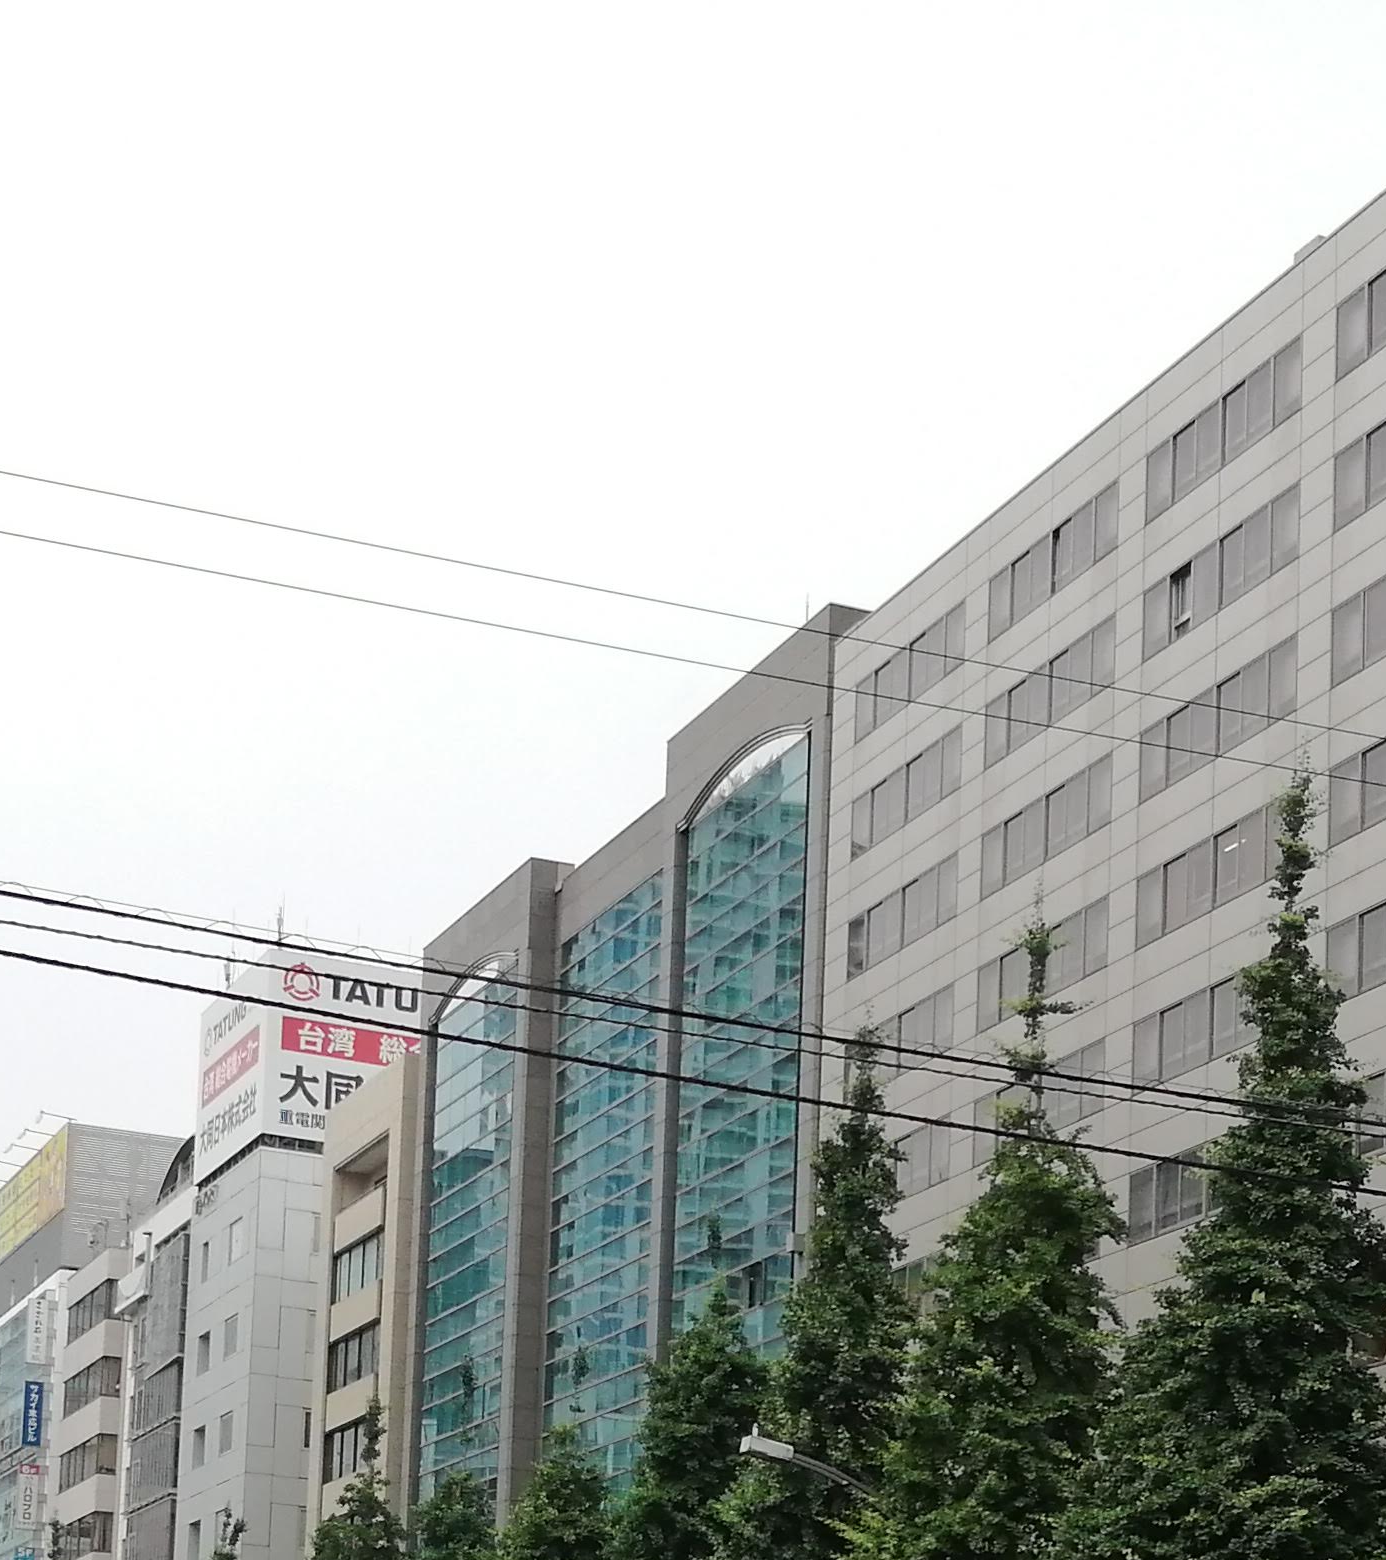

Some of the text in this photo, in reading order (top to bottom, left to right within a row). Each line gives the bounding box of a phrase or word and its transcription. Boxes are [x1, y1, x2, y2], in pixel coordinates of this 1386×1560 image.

[212, 1002, 247, 1045] TATUNG
[297, 1022, 356, 1058] 台湾
[279, 1065, 364, 1111] 大同
